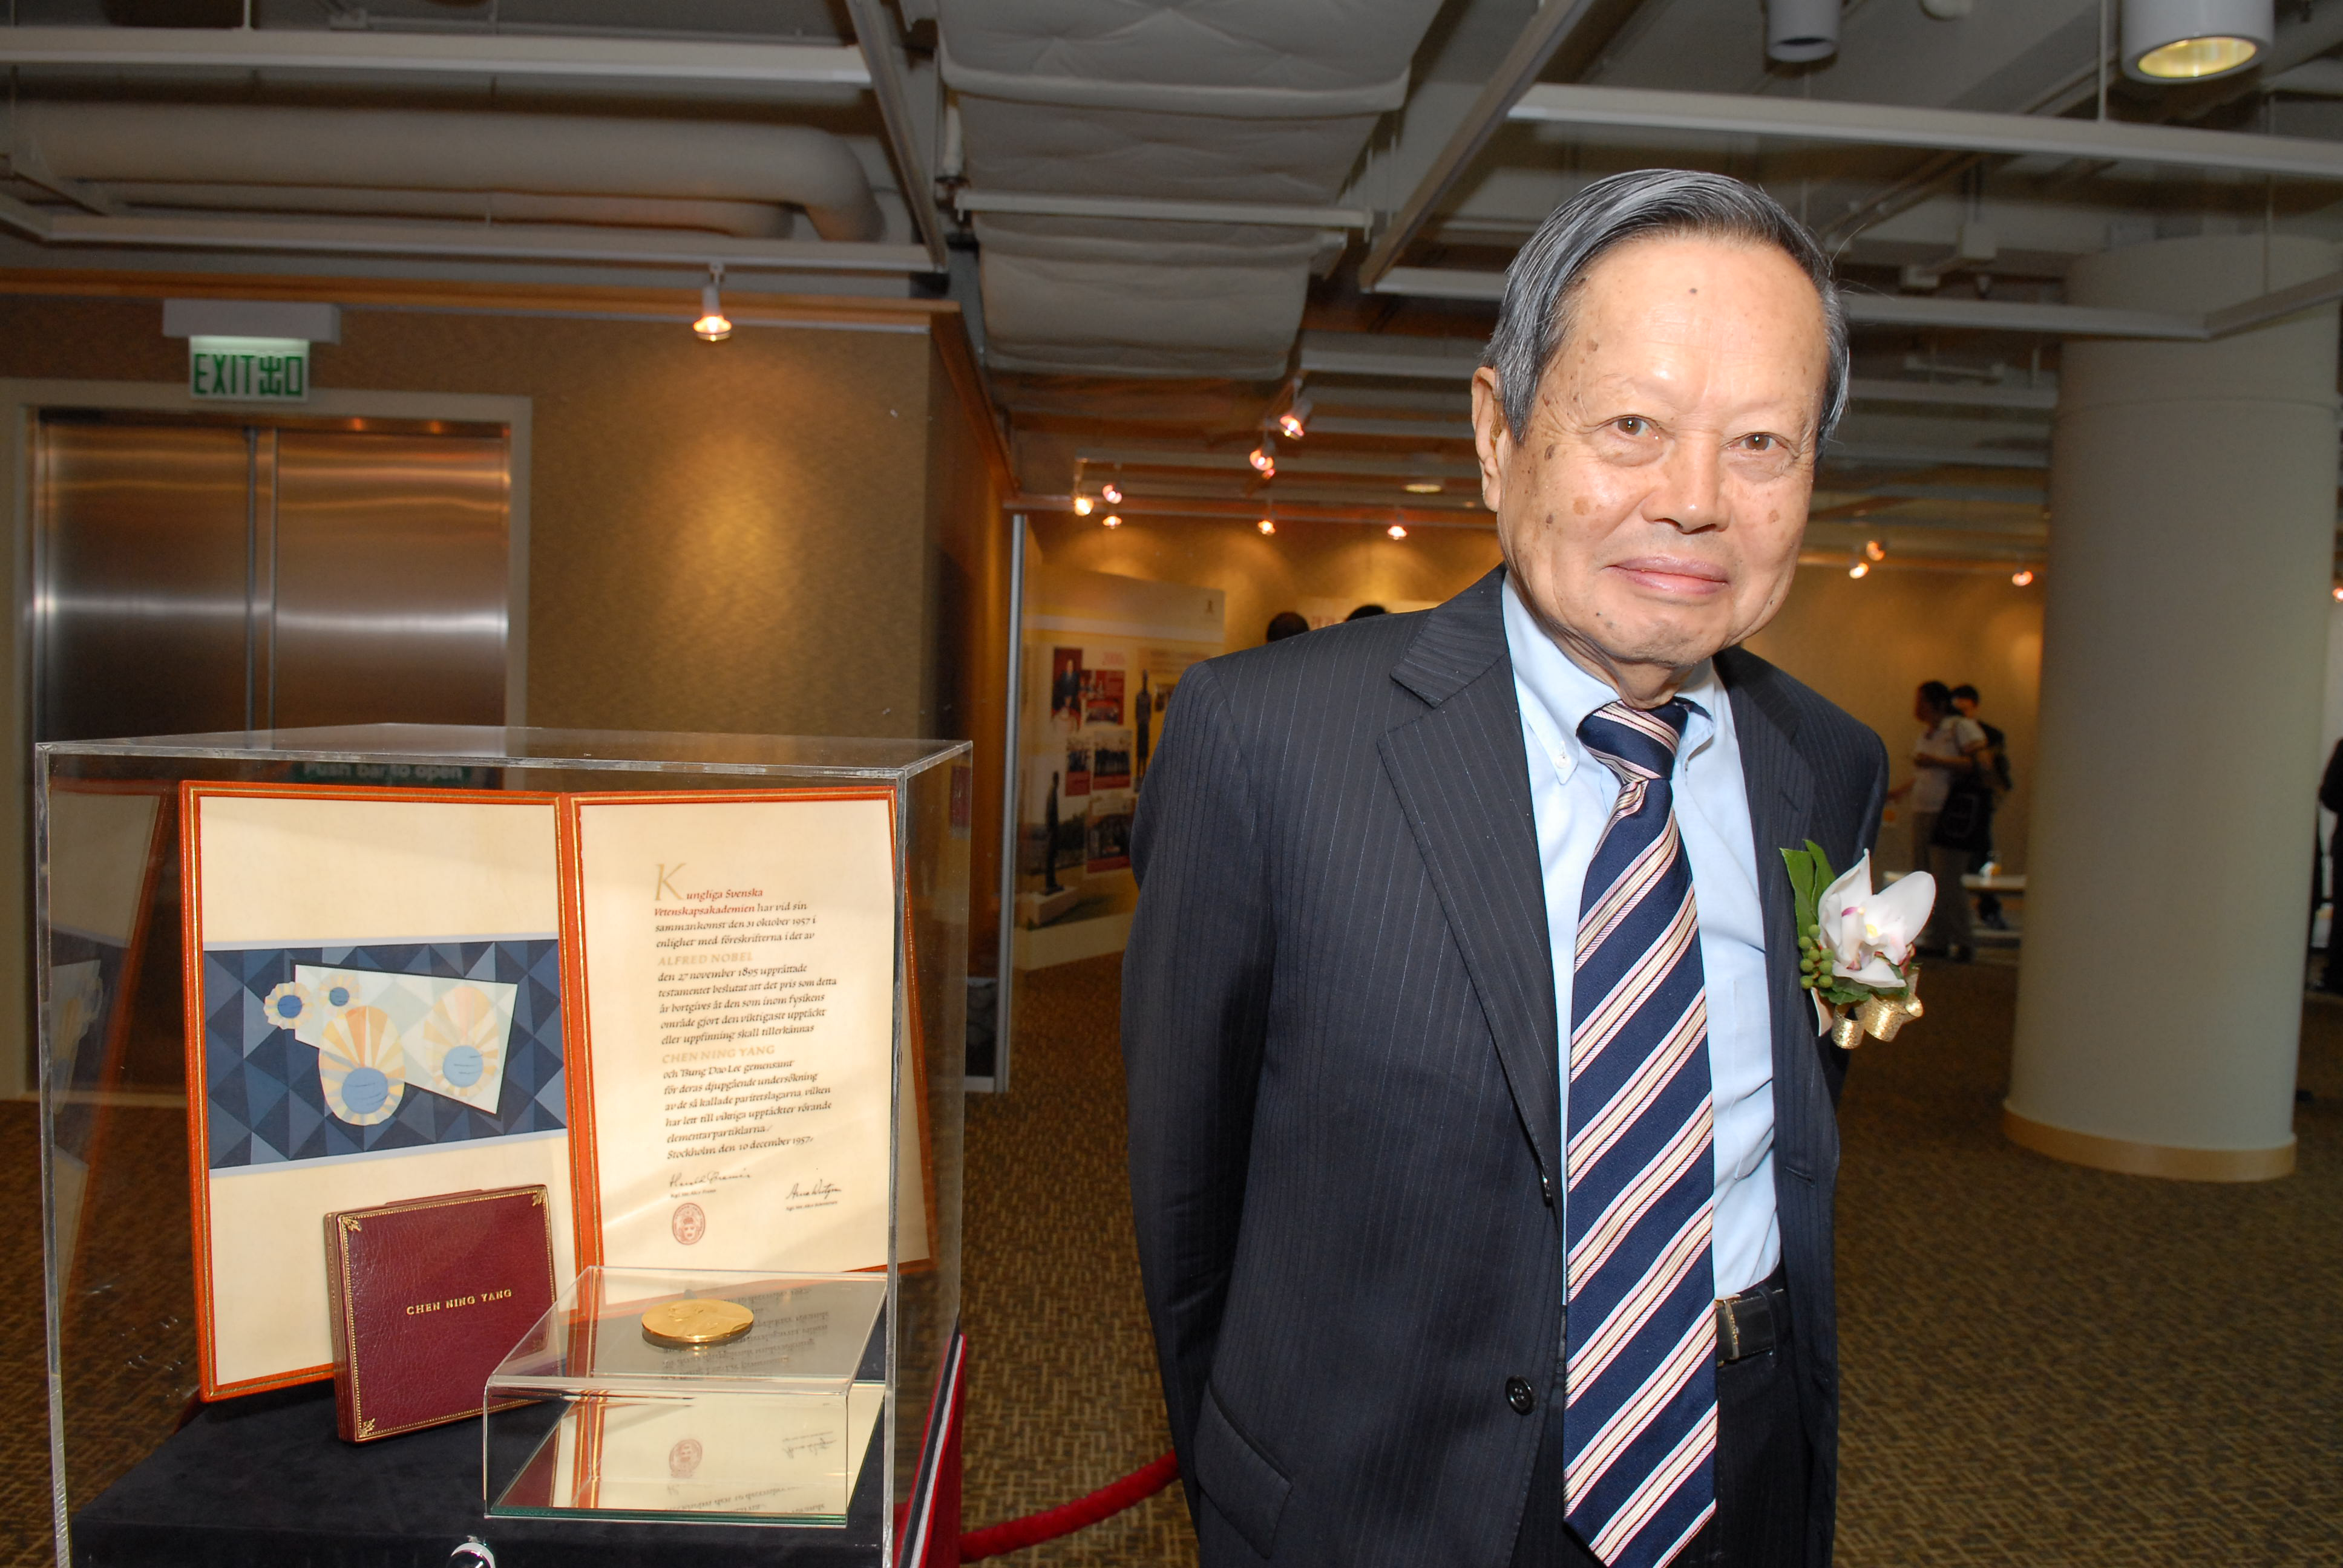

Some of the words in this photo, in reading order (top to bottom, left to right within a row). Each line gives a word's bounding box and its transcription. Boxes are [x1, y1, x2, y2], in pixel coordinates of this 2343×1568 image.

[194, 353, 255, 394] EXIT
[259, 356, 302, 396] 出口
[726, 887, 763, 899] Svenska
[655, 904, 755, 917] Vetenskapsakademien
[757, 903, 775, 912] har
[775, 901, 790, 912] vid
[793, 901, 807, 910] sin
[655, 920, 727, 932] sammankomst
[728, 919, 745, 929] den
[756, 918, 790, 927] oktober
[793, 917, 811, 926] 1957
[657, 937, 696, 949] enlighet
[698, 936, 718, 946] med
[790, 930, 804, 939] det
[657, 954, 707, 966] ALFRED
[711, 951, 753, 963] NOBEL
[658, 972, 675, 982] den
[678, 972, 690, 981] 27
[690, 968, 734, 980] november
[738, 967, 759, 978] 1895
[658, 985, 710, 998] testamentet
[713, 983, 747, 994] beslutat
[749, 982, 761, 991] att
[763, 981, 778, 990] det
[780, 978, 796, 991] pris
[798, 978, 814, 987] som
[816, 976, 837, 986] detta
[672, 1000, 712, 1014] bortgives
[724, 998, 740, 1009] den
[742, 999, 761, 1007] som
[762, 996, 787, 1006] inom
[788, 993, 825, 1008] fysikens
[661, 1017, 695, 1029] område
[697, 1016, 720, 1029] gjort
[721, 1014, 739, 1025] den
[740, 1010, 786, 1023] viktigaste
[661, 1035, 681, 1045] eller
[683, 1030, 735, 1045] uppfinning
[737, 1028, 759, 1039] skall
[662, 1052, 698, 1063] CHEN
[701, 1048, 736, 1060] NING
[739, 1045, 775, 1057] YANG
[663, 1069, 678, 1079] och
[708, 1066, 727, 1076] Dao
[728, 1064, 742, 1073] Lee
[743, 1060, 795, 1074] gemensamt
[679, 1083, 703, 1094] deras
[704, 1078, 757, 1093] djupgående
[665, 1103, 677, 1111] av
[678, 1100, 688, 1109] de
[689, 1099, 698, 1109] så
[700, 1096, 733, 1108] kallade
[804, 1086, 831, 1096] vilken
[666, 1117, 681, 1127] har
[683, 1116, 698, 1126] lett
[700, 1113, 713, 1123] till
[715, 1111, 747, 1122] viktiga
[667, 1146, 716, 1160] Stockholm
[719, 1144, 736, 1154] den
[739, 1143, 749, 1152] 10
[750, 1137, 791, 1149] december
[406, 1301, 441, 1315] CHEN
[445, 1295, 476, 1308] NING
[481, 1289, 512, 1302] YANG
